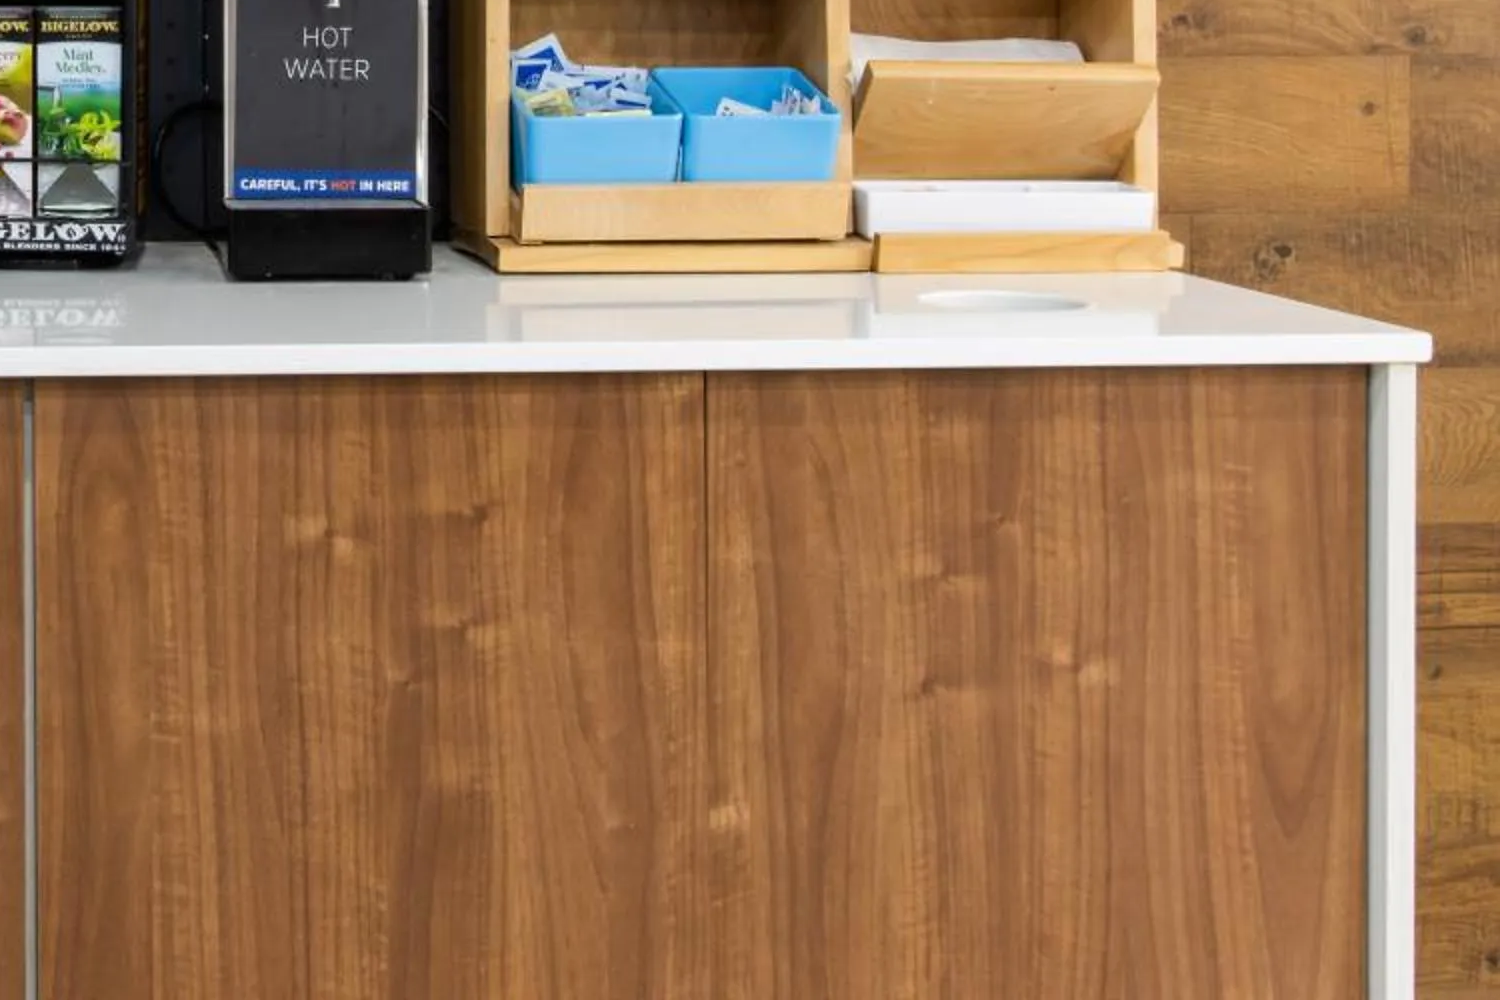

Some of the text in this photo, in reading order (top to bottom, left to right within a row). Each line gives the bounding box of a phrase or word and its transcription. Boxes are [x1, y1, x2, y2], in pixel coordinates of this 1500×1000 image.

[40, 21, 119, 33] BIGELOW
[302, 26, 353, 49] HOT
[63, 48, 93, 61] Mint
[284, 58, 371, 81] WATER
[240, 179, 410, 193] CAREFUL, IT'S HOT IN HERE
[3, 242, 60, 251] BLENDERS
[64, 243, 97, 252] SINCE
